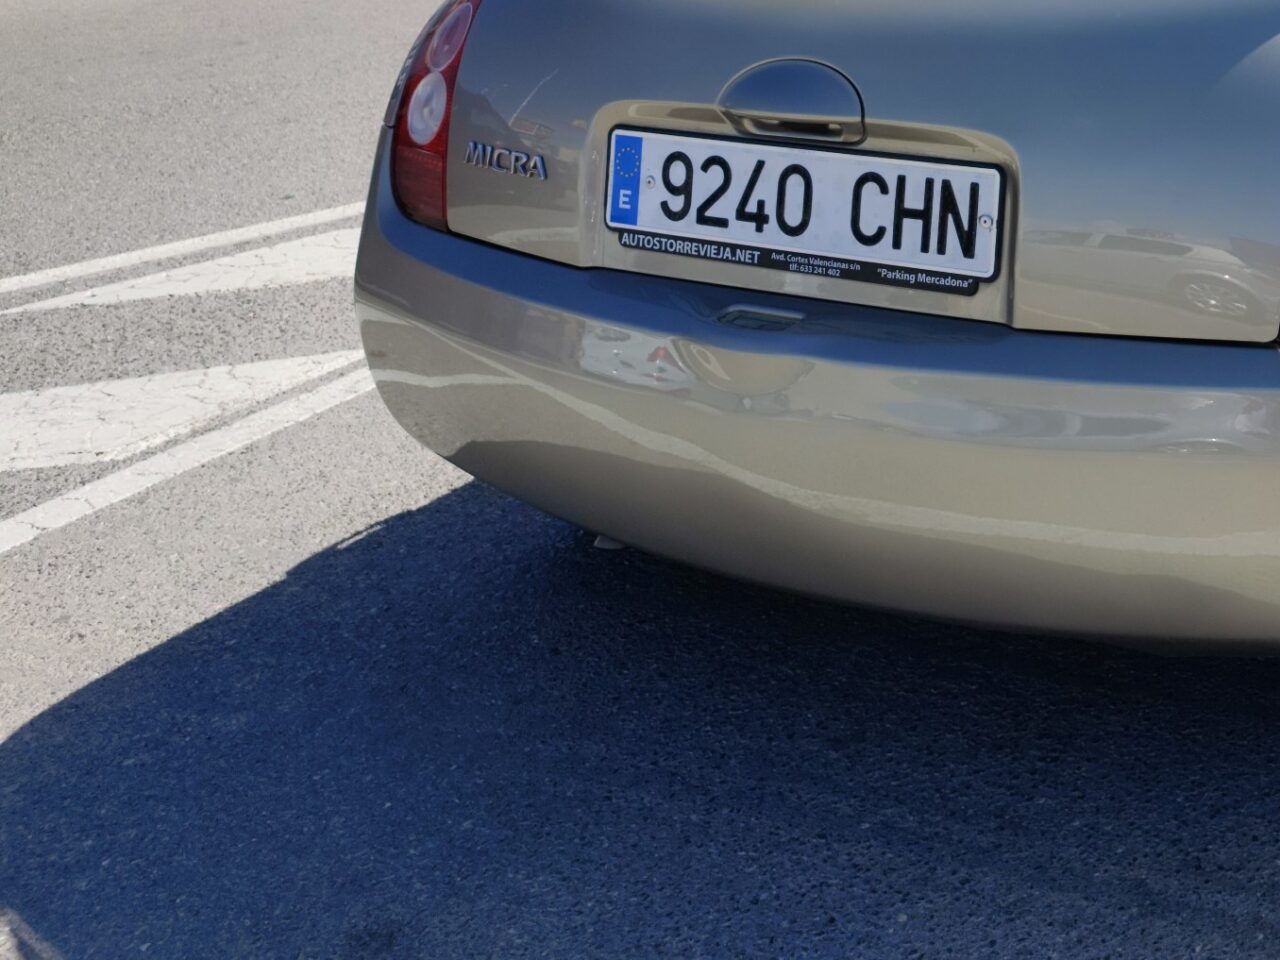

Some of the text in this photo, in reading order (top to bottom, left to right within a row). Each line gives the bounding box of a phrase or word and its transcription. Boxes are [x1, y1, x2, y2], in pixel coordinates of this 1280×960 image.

[464, 139, 548, 181] MICRA
[618, 188, 633, 209] E
[660, 150, 981, 259] 9240 CHN
[621, 231, 761, 265] AUTOSTORREVIEJA.NET
[770, 252, 786, 262] Avd.
[809, 257, 849, 270] Valencianas
[849, 263, 861, 271] s/n
[800, 265, 813, 273] 633
[827, 268, 841, 277] 402
